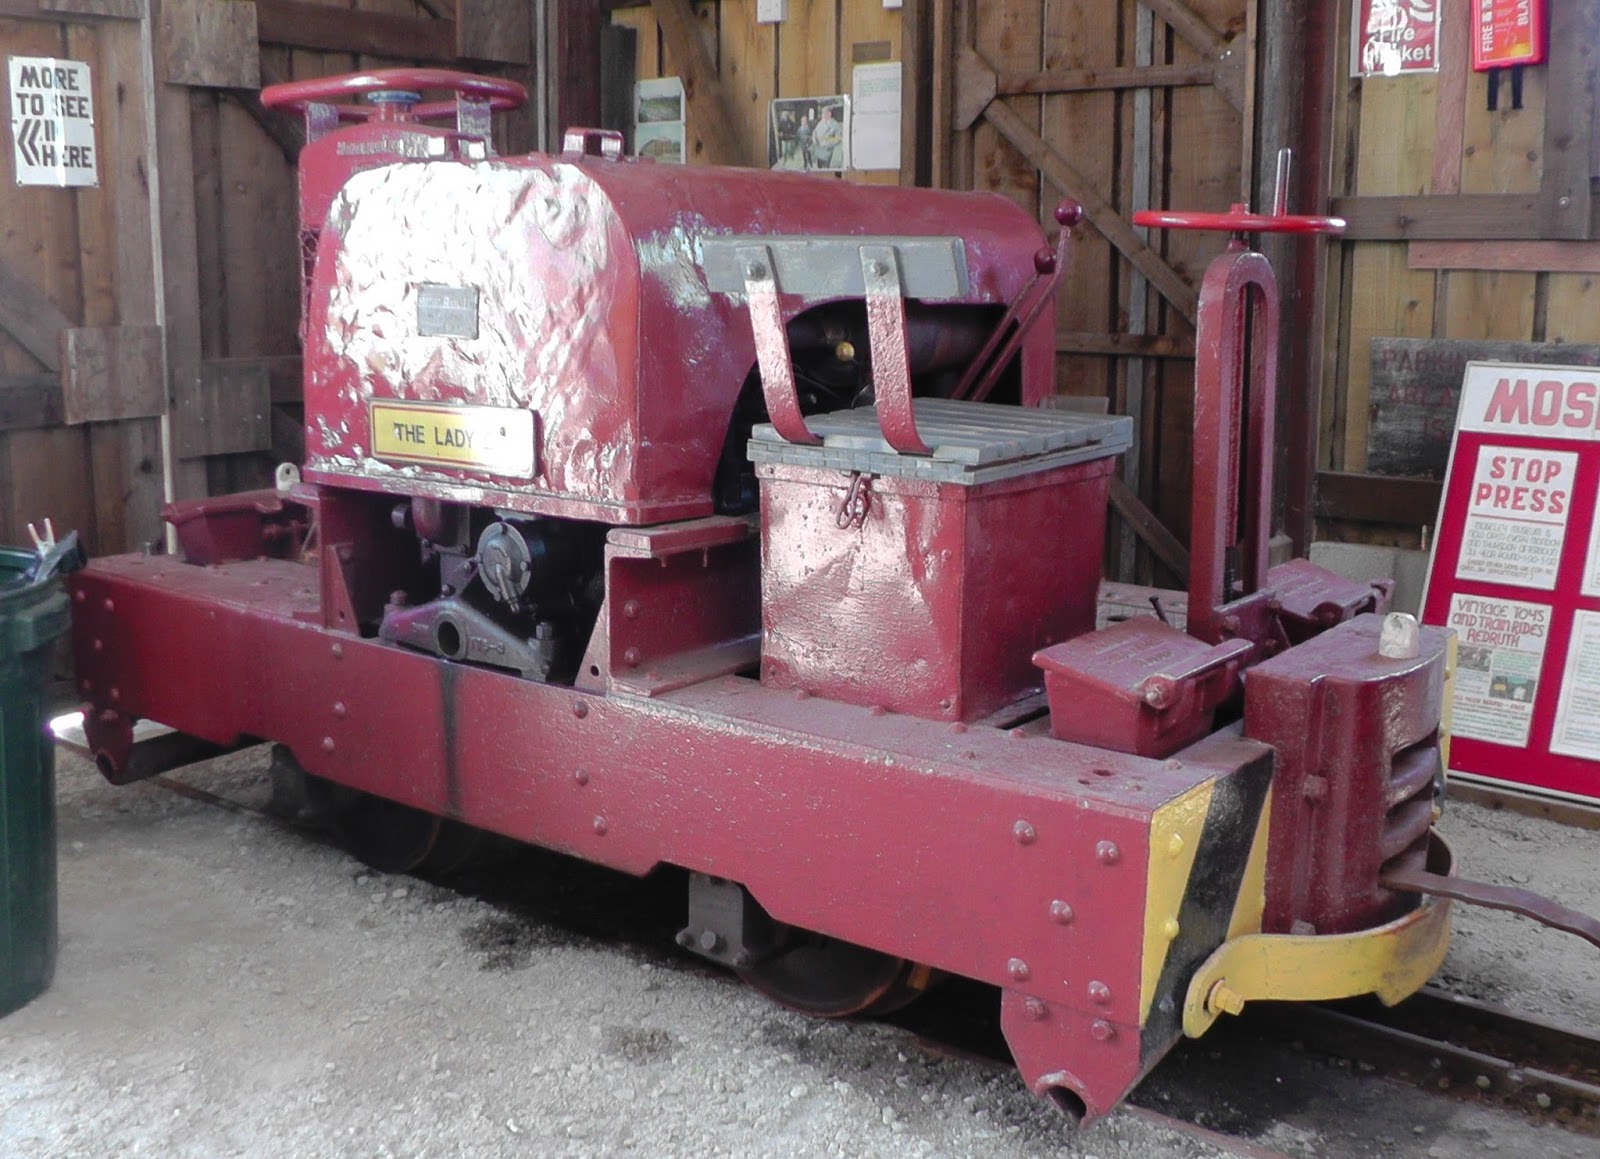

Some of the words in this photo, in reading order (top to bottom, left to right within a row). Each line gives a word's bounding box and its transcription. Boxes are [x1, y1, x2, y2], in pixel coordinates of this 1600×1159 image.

[1482, 24, 1494, 52] FIRE
[20, 66, 80, 91] MORE
[16, 92, 45, 116] TO
[1483, 377, 1600, 431] MOS
[393, 422, 425, 444] THE
[434, 427, 474, 449] LADY
[1489, 455, 1562, 484] STOP
[1475, 482, 1566, 514] PRESS
[1512, 606, 1545, 623] TOYS
